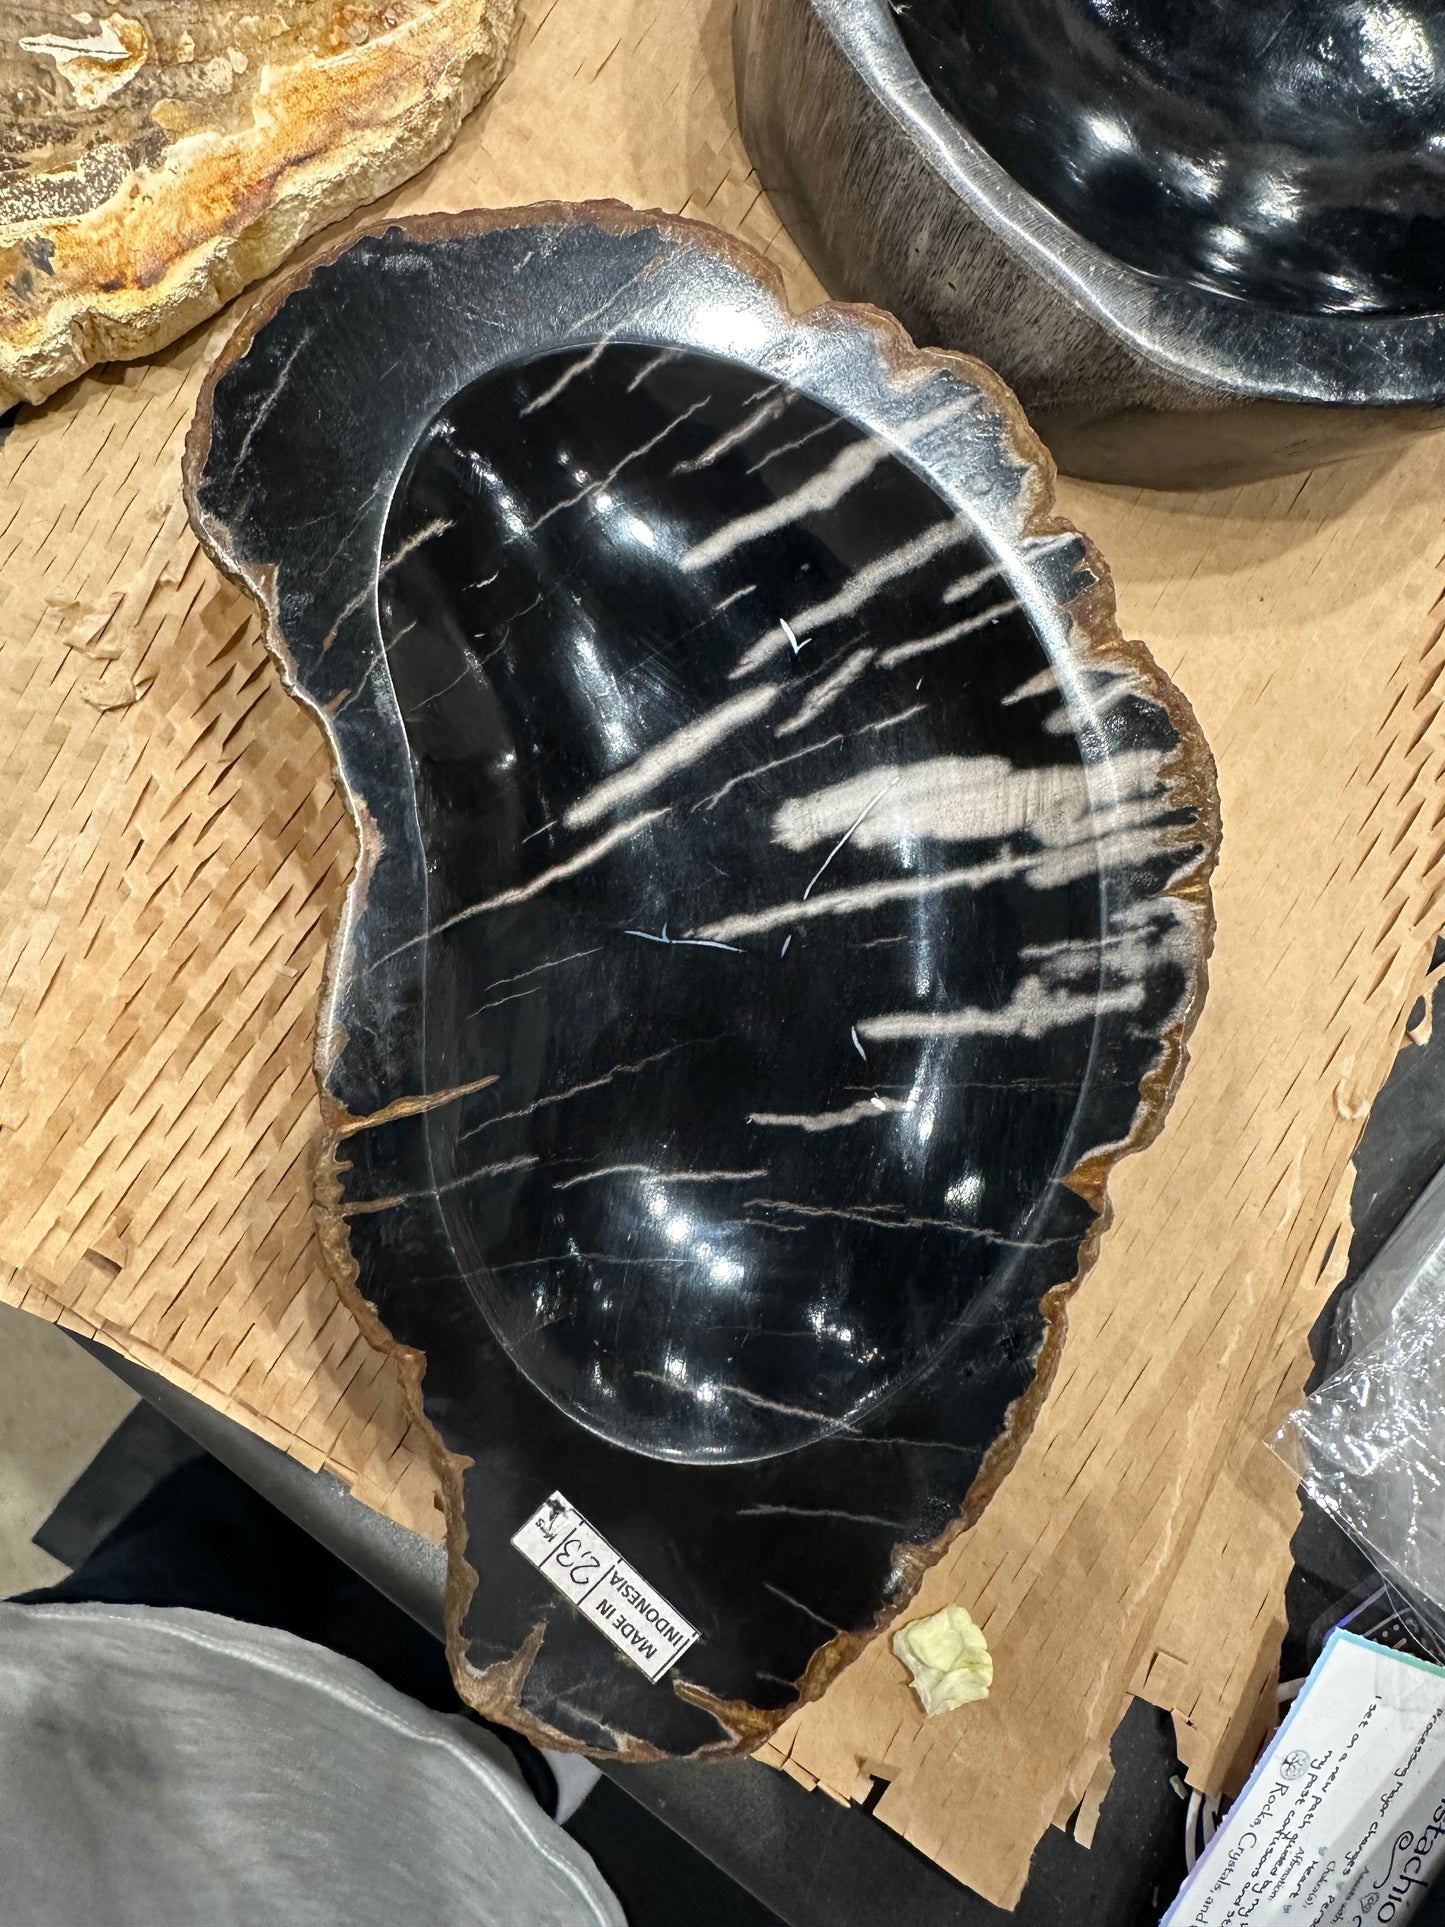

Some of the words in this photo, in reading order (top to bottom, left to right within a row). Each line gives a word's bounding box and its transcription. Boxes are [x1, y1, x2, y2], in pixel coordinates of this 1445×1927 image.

[556, 1540, 600, 1585] 2,3
[595, 1598, 617, 1620] IN
[609, 1570, 684, 1648] INDONESIA
[612, 1614, 658, 1660] MADE
[1358, 1703, 1377, 1728] set
[1338, 1752, 1348, 1762] a
[1346, 1733, 1359, 1749] on
[1393, 1708, 1443, 1777] Processing
[1310, 1750, 1333, 1770] my
[1294, 1772, 1318, 1806] past
[1321, 1766, 1340, 1793] new
[1249, 1781, 1290, 1828] Rocks,
[1298, 1795, 1323, 1830] path
[1379, 1781, 1403, 1818] Major
[1251, 1810, 1295, 1878] confusions
[1270, 1831, 1299, 1876] guided
[1378, 1798, 1445, 1923] stachio
[1209, 1832, 1257, 1893] Crystals,
[1288, 1860, 1319, 1899] Heart
[1233, 1881, 1251, 1906] and
[1251, 1879, 1273, 1894] by
[1195, 1896, 1214, 1924] and
[1237, 1898, 1260, 1918] my
